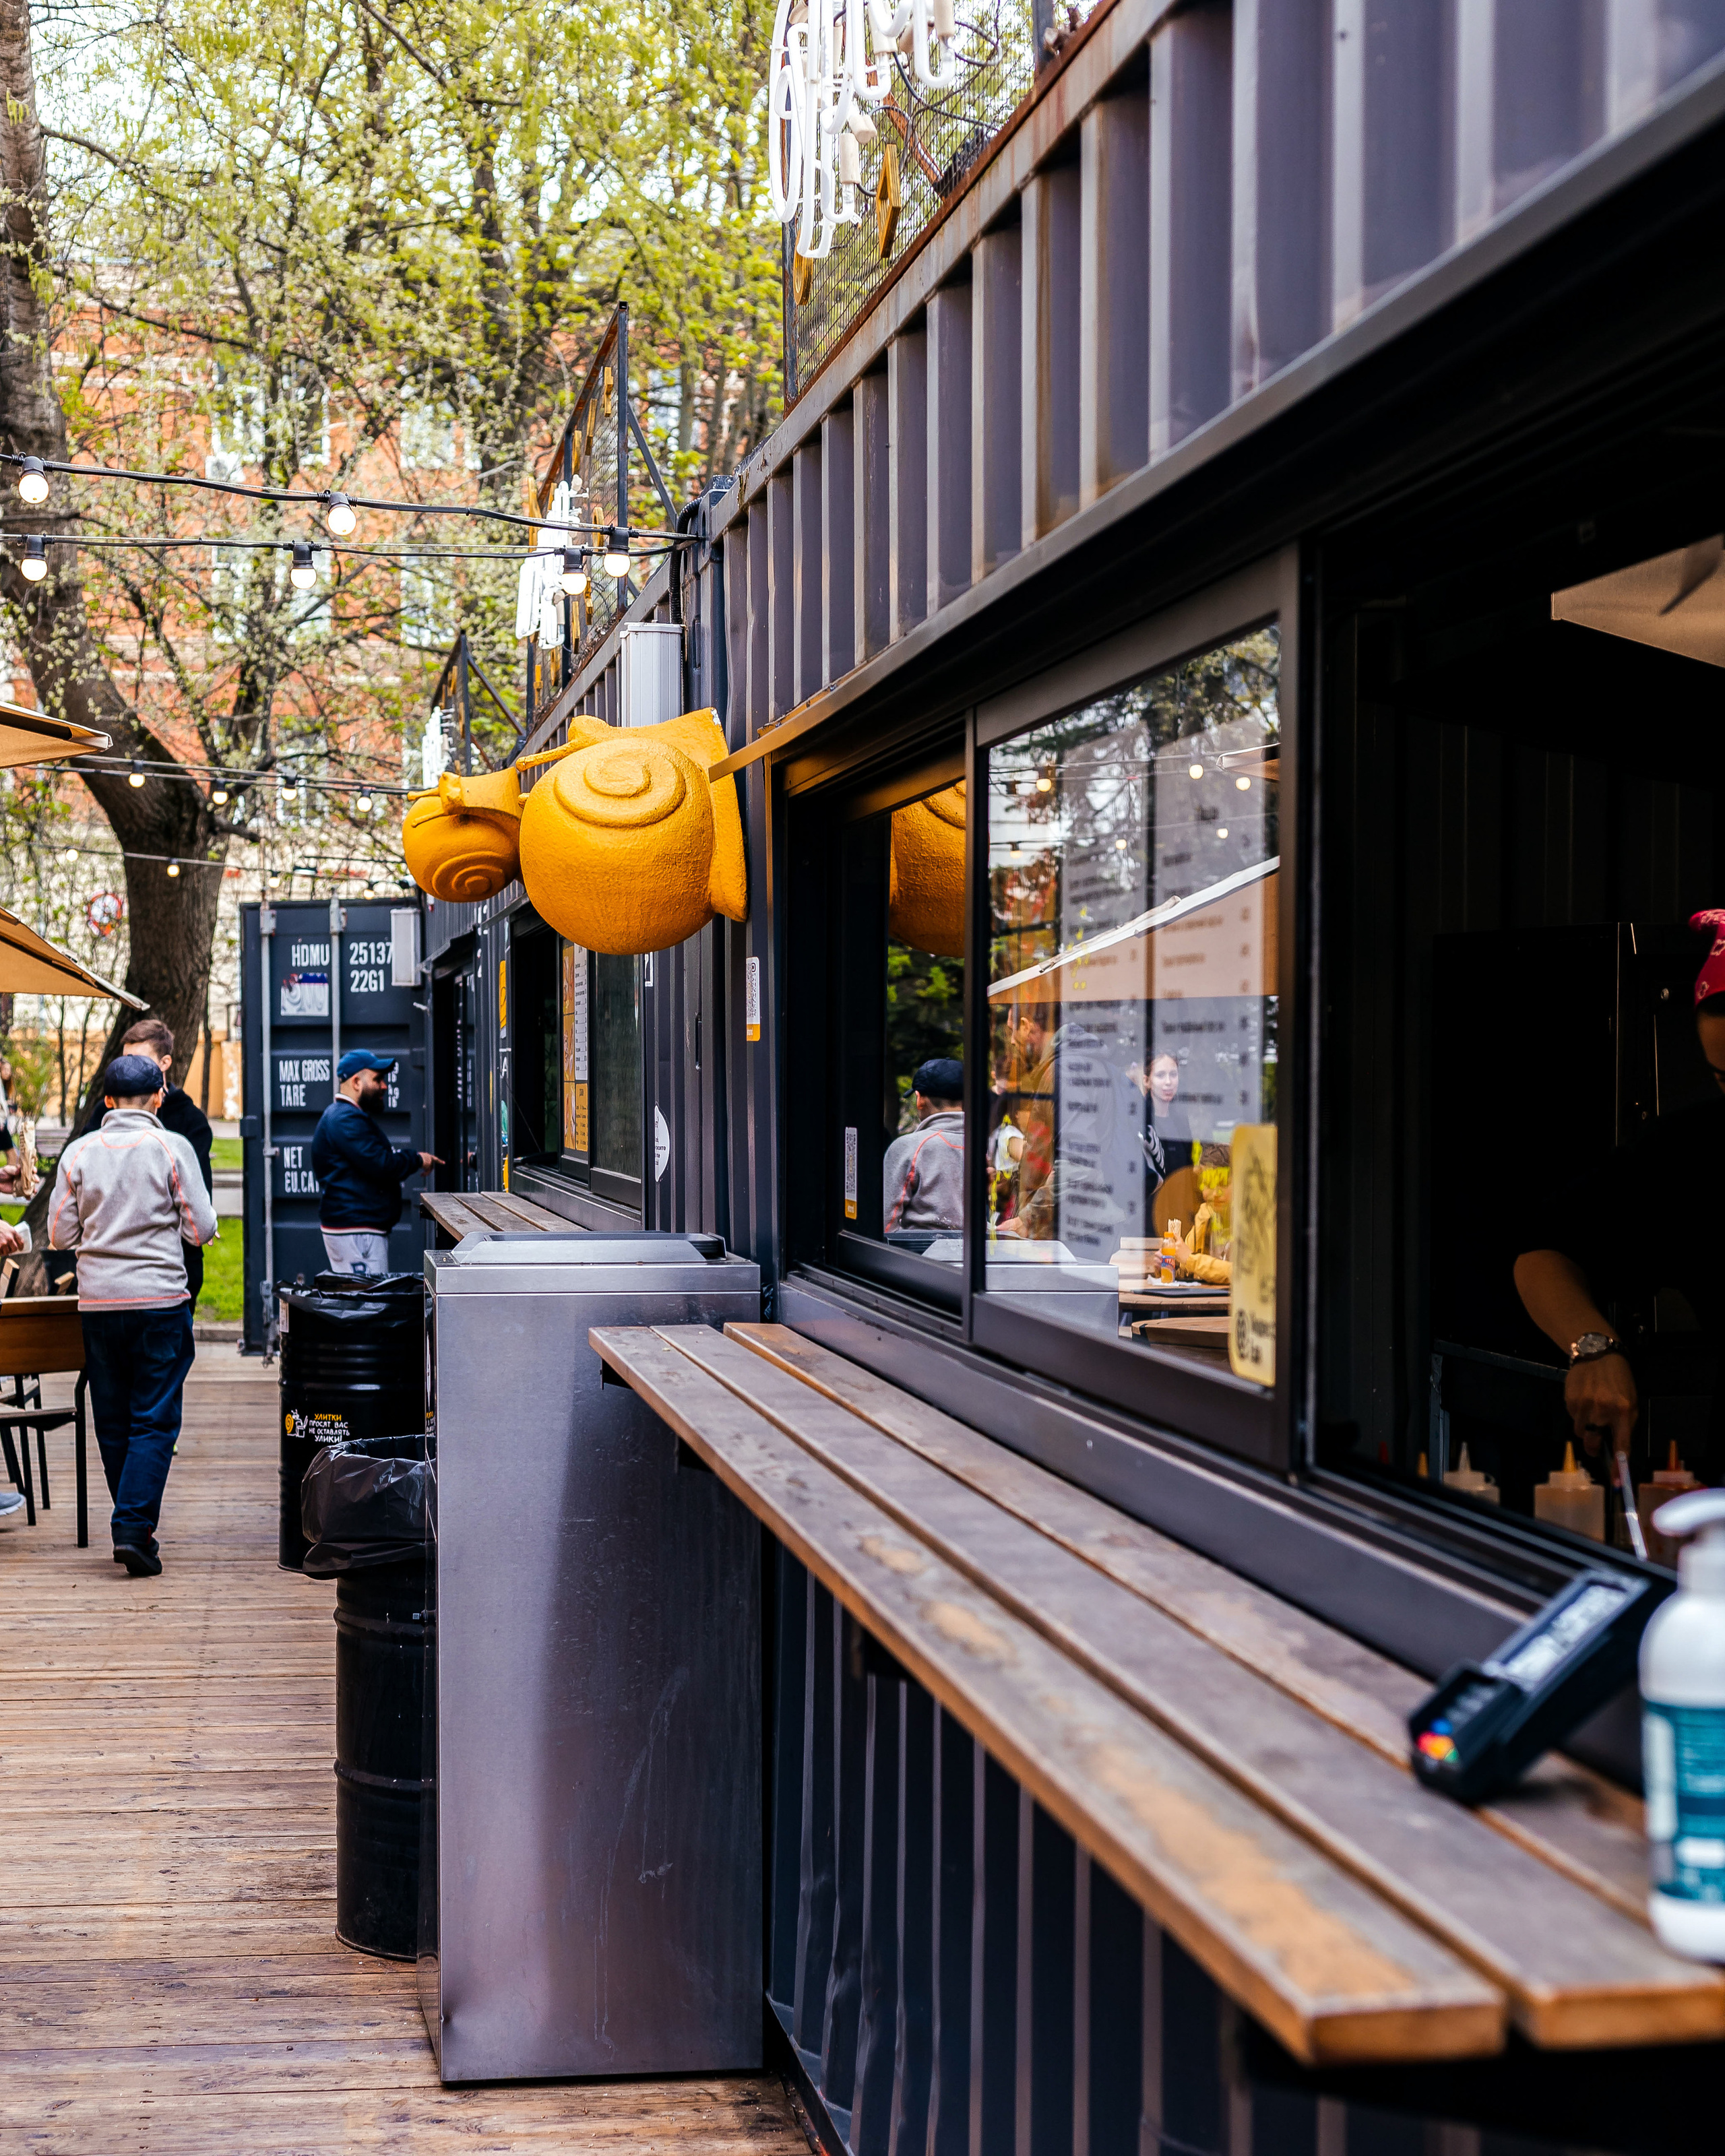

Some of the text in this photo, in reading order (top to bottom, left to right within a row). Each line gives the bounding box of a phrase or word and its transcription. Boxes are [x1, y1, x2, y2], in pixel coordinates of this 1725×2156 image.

[291, 944, 330, 968] HDMU
[350, 969, 385, 992] 22G1
[279, 1059, 330, 1083] MAX GROSS
[280, 1084, 307, 1107] TARE
[284, 1146, 303, 1169] NET
[309, 1420, 331, 1428] ПРОСЯТ
[314, 1413, 342, 1422] УЛИТКИ
[317, 1428, 350, 1436] ОСТАВЛЯТЬ
